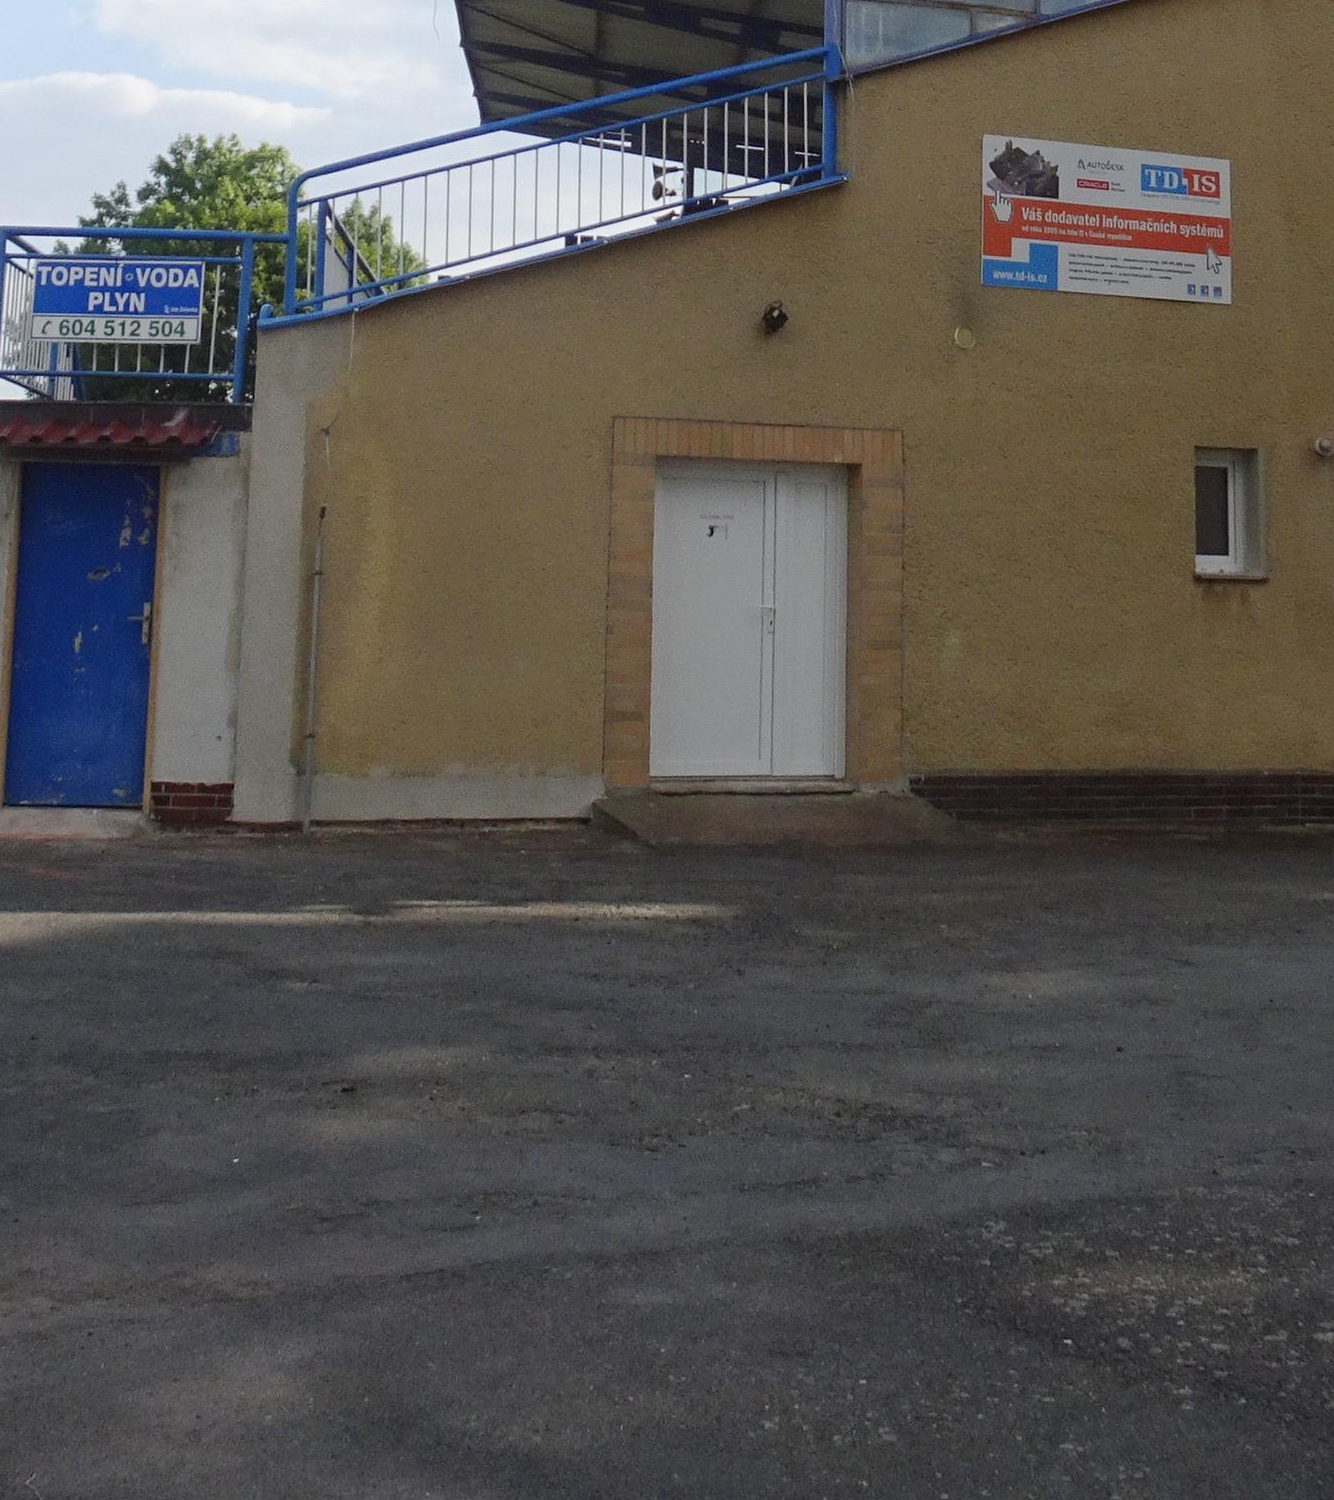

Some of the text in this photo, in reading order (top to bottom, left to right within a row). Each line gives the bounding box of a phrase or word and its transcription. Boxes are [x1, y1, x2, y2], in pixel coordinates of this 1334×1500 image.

[1078, 180, 1108, 189] ORACLE
[1021, 206, 1225, 240] Váš dodavatel informačních systémů
[38, 264, 199, 288] TOPENÍ VODA
[993, 269, 1048, 283] www.td-is.cz
[88, 292, 145, 312] PLYN
[59, 319, 185, 338] 604 512 504
